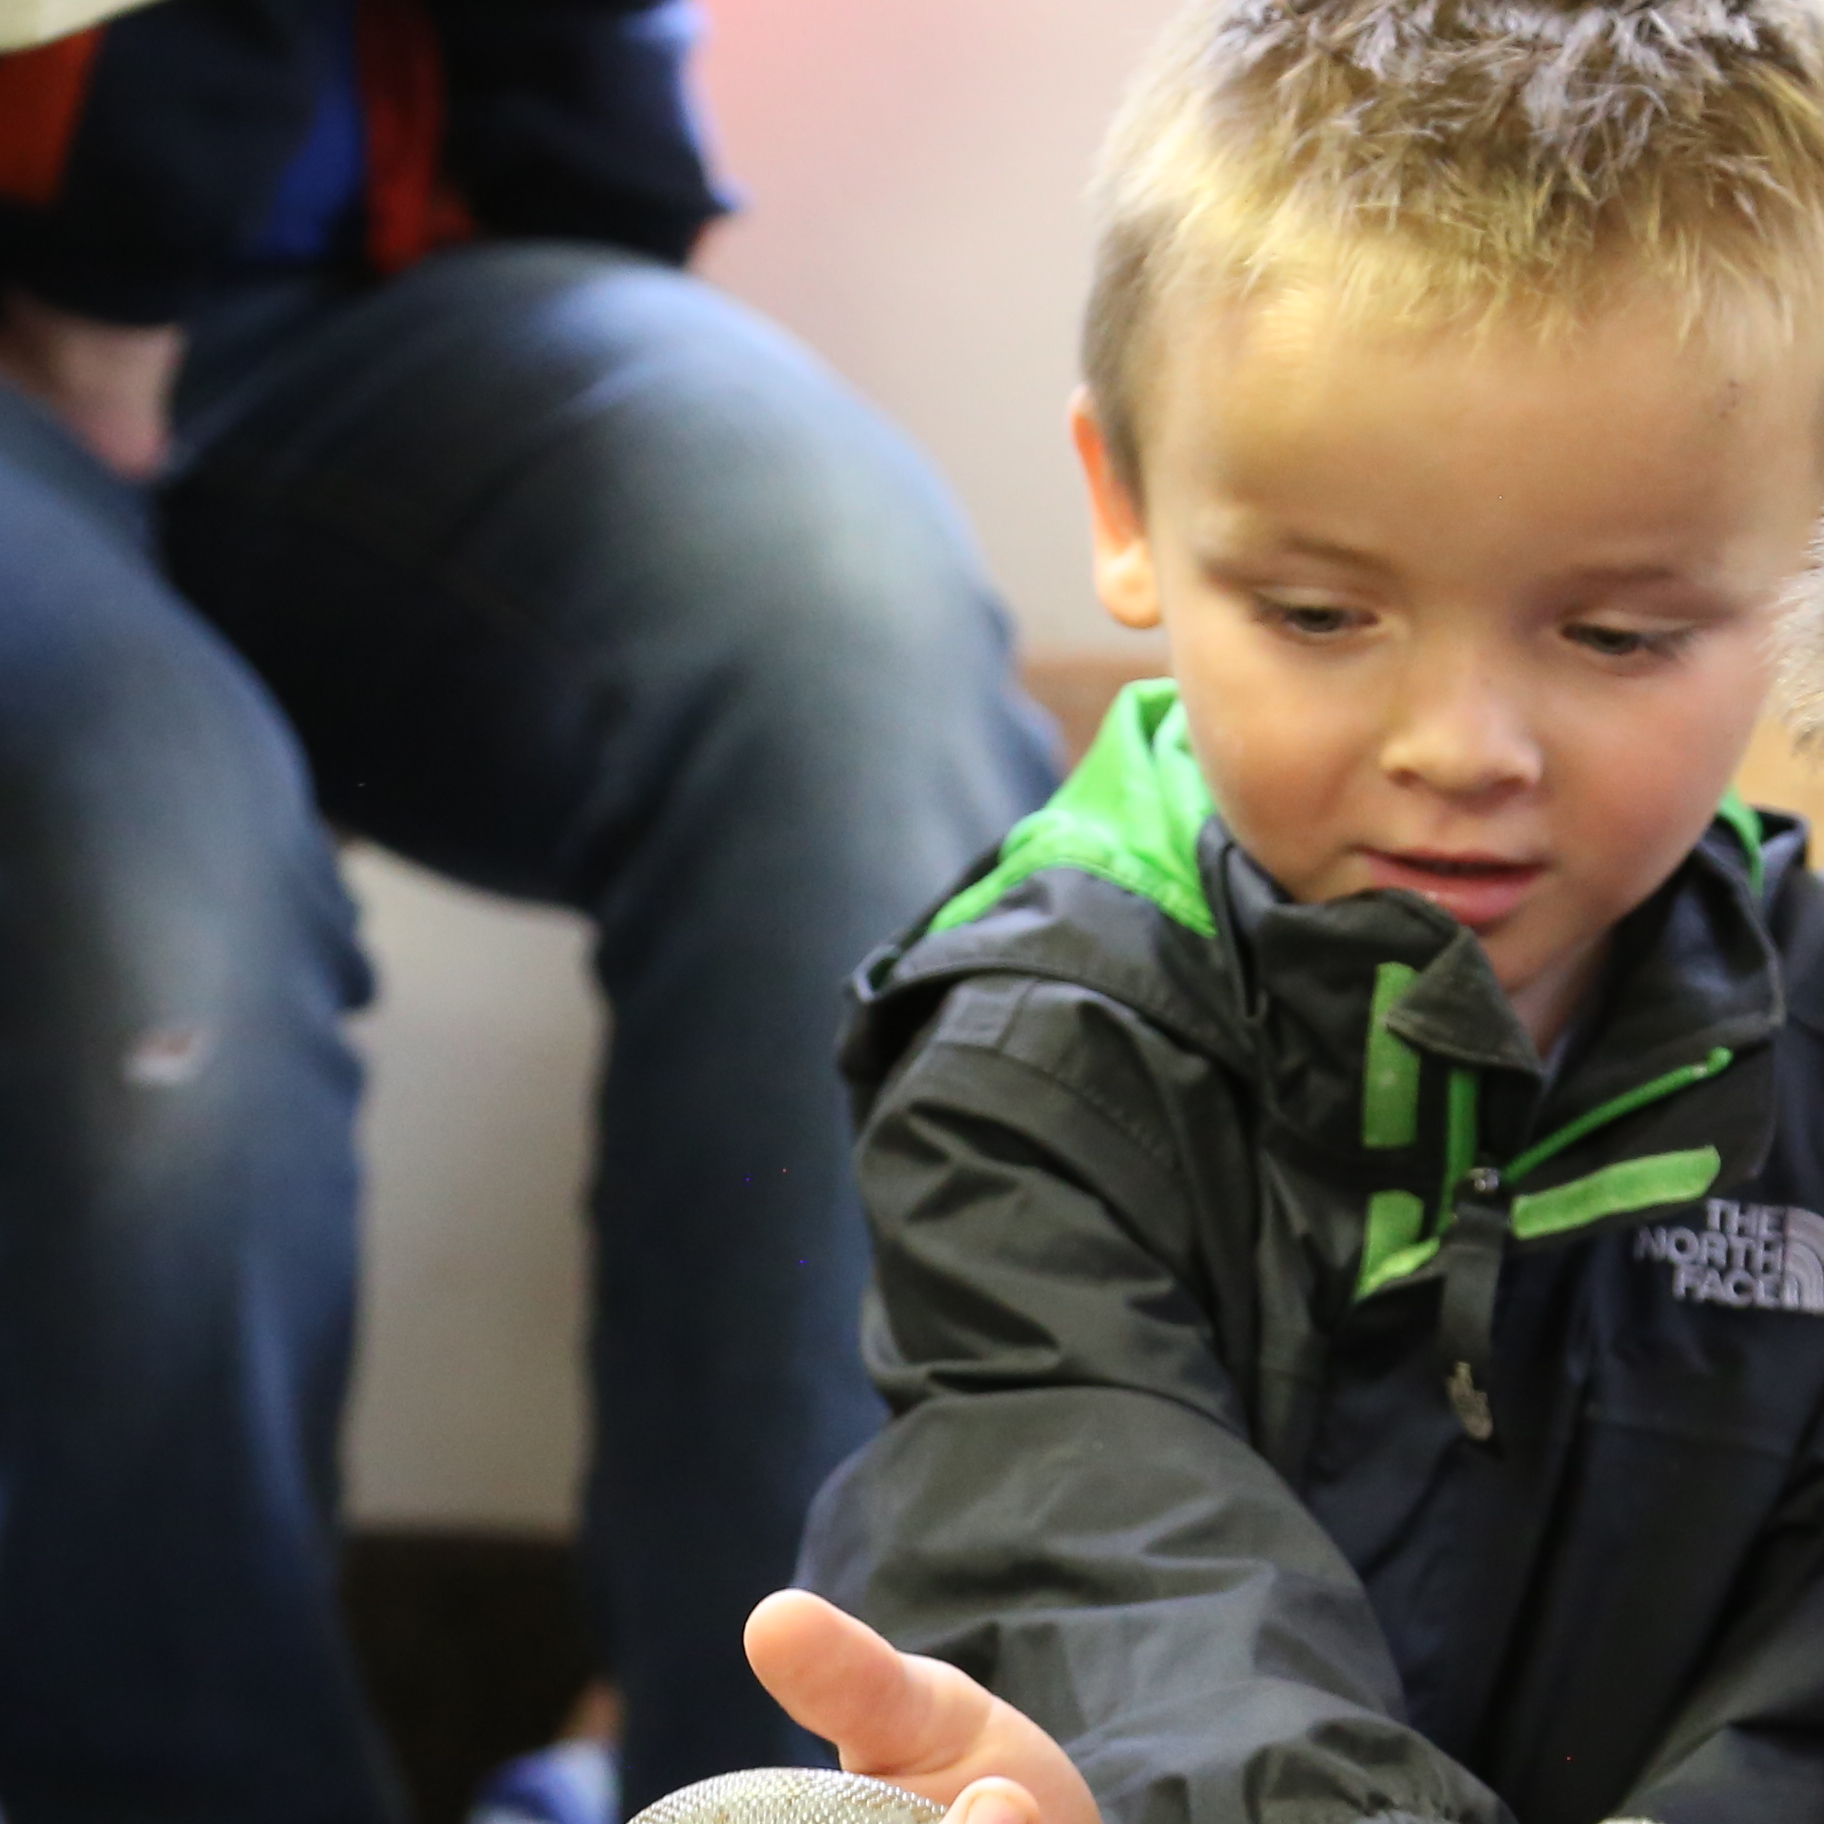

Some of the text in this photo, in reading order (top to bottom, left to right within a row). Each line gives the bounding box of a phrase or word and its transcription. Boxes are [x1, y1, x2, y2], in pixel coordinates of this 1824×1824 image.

[1706, 1198, 1782, 1238] THE
[1634, 1225, 1783, 1274] NORTH
[1673, 1262, 1782, 1309] FACE
